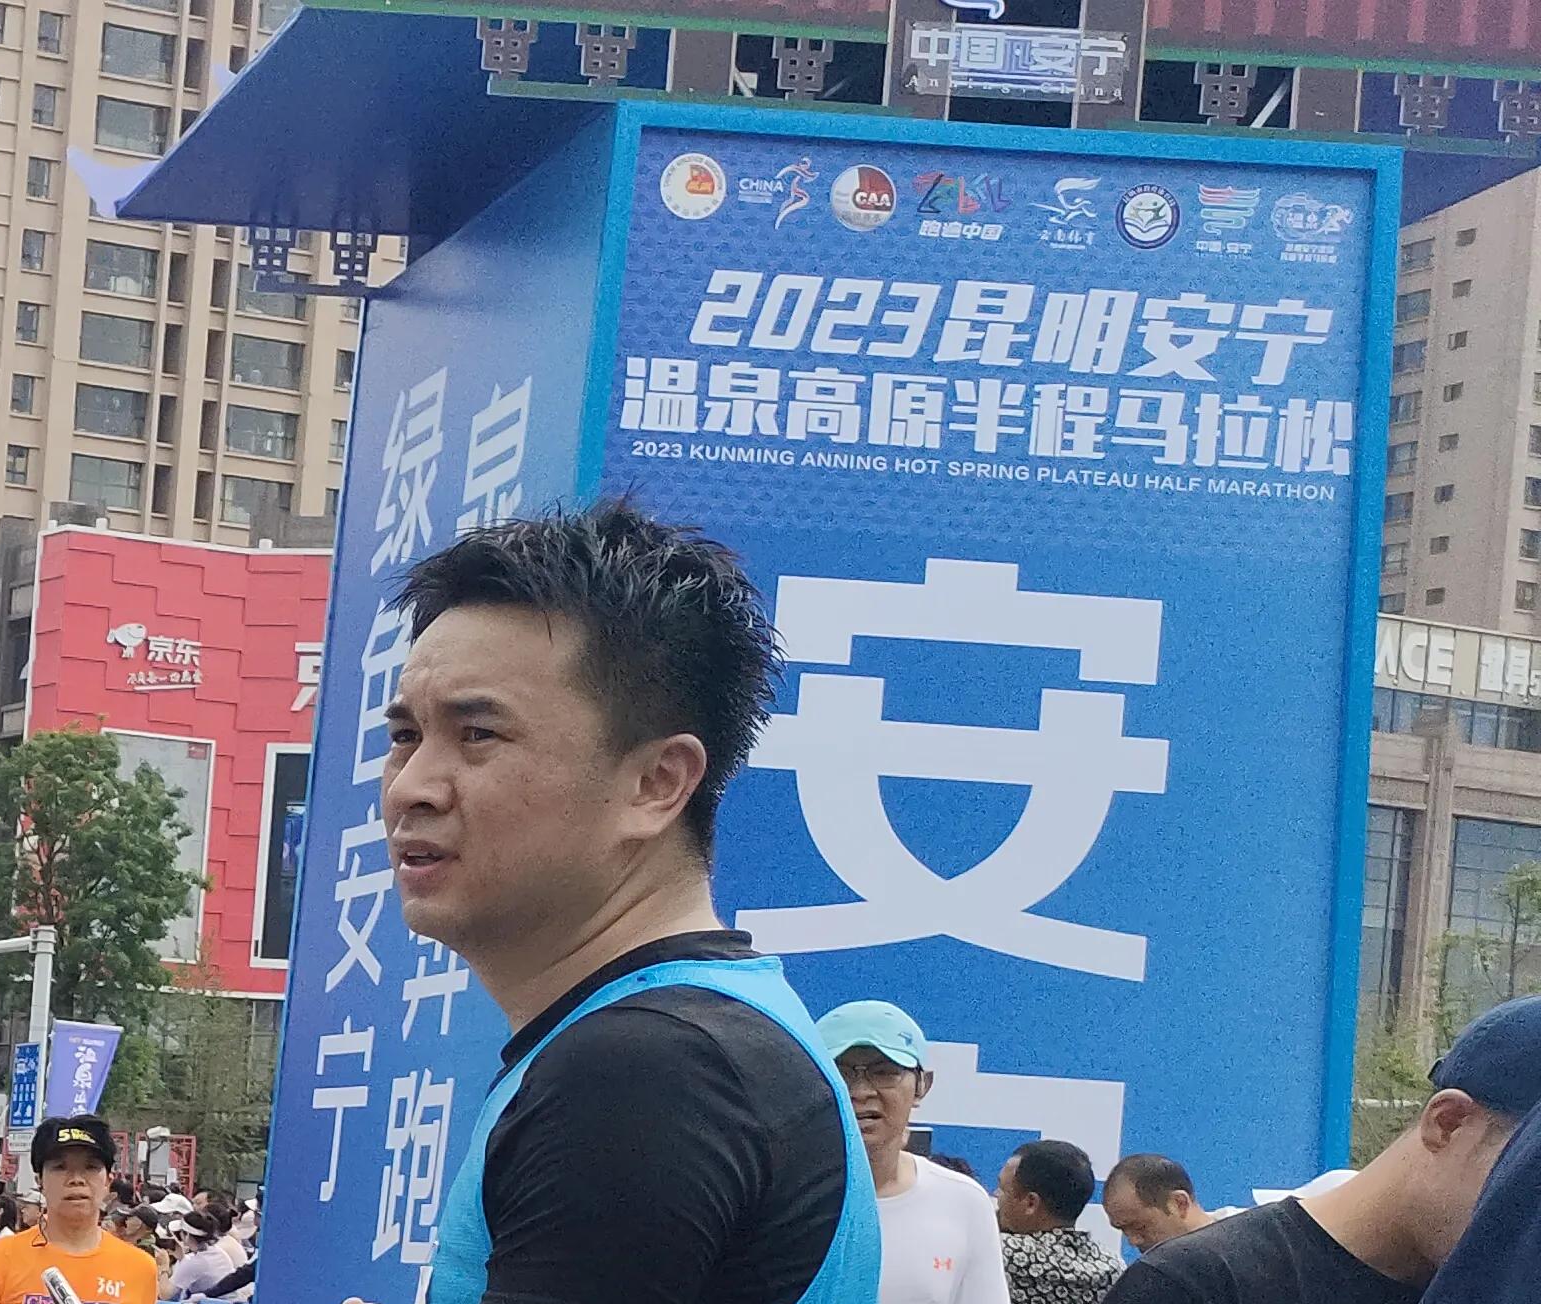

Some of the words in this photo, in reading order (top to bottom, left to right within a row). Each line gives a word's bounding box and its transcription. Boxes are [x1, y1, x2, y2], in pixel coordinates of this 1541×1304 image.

[739, 178, 785, 193] CHINA
[855, 191, 892, 207] CAA
[918, 219, 1004, 241] 跑遍中国
[689, 269, 1334, 385] 2023昆明安宁
[619, 355, 1355, 476] 温泉高原半程马拉松
[631, 440, 683, 460] 2023
[689, 443, 795, 466] KUNMING
[800, 451, 887, 472] ANNING
[894, 457, 941, 475] HOT
[947, 460, 1030, 480] SPRING
[1036, 466, 1138, 489] PLATEAU
[1144, 474, 1202, 493] HALF
[1207, 478, 1336, 501] MARATHON
[147, 635, 202, 666] 京东
